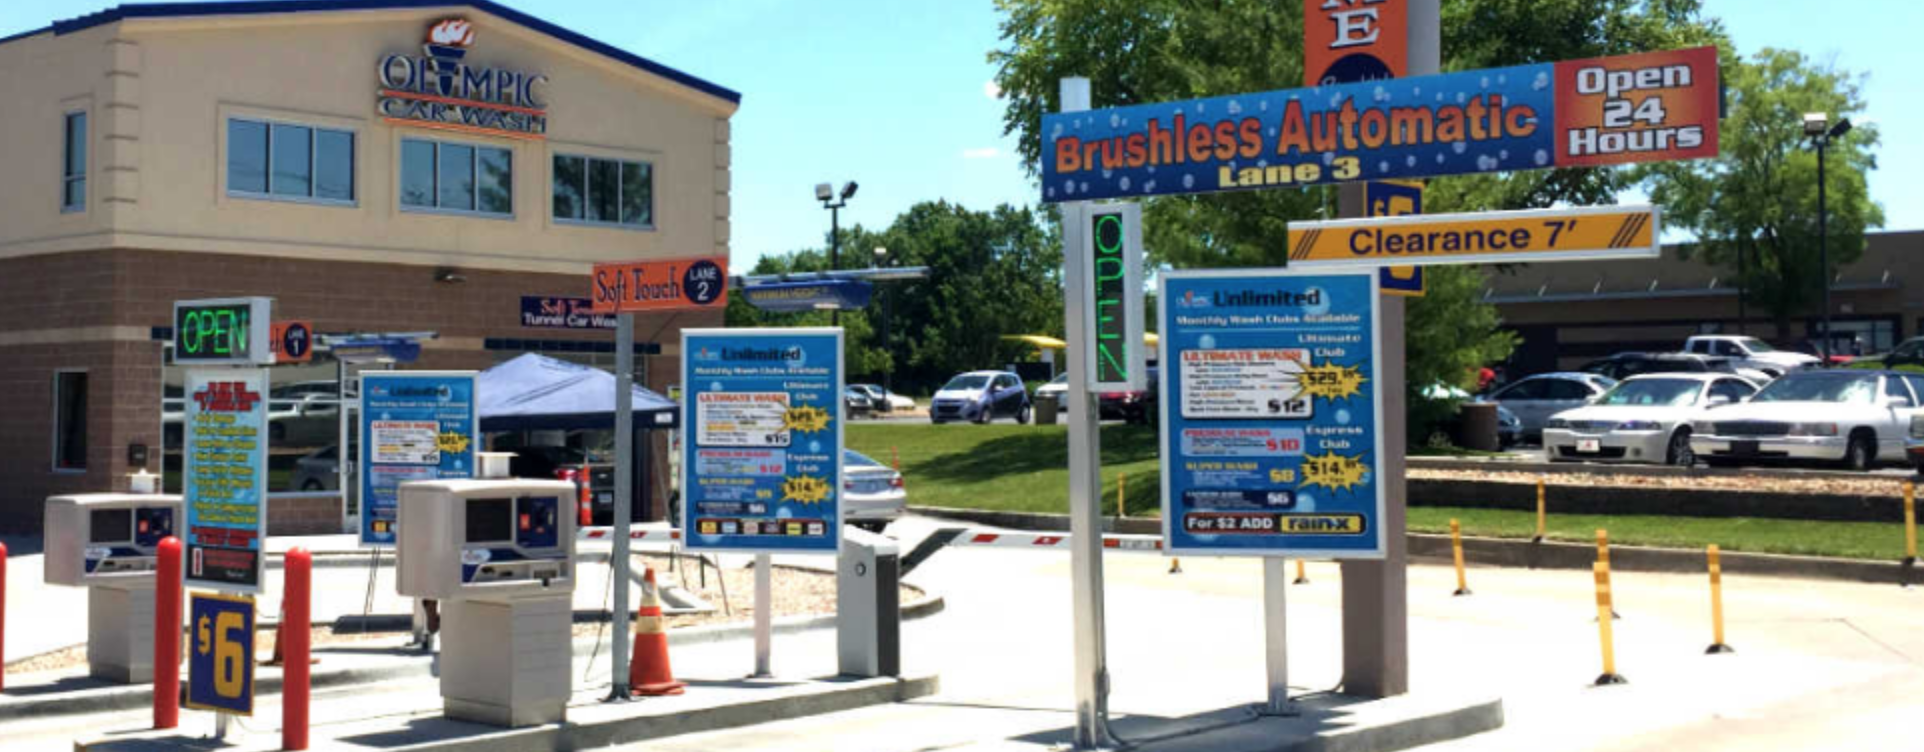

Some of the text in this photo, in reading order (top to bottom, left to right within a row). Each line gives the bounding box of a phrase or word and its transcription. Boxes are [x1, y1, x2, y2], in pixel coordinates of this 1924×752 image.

[1576, 65, 1692, 98] Open
[379, 98, 547, 134] CAR WASH
[1603, 96, 1667, 127] 24
[1056, 94, 1538, 174] Brushless Automatic
[1568, 125, 1703, 156] Hours
[1218, 156, 1361, 188] Lane 3
[1348, 227, 1531, 256] Clearance
[689, 267, 716, 281] LANE
[596, 266, 681, 315] Soft Touch
[697, 281, 709, 301] 2
[1095, 215, 1128, 381] OPEN
[1213, 289, 1320, 307] Unlimited
[183, 309, 249, 353] OPEN
[524, 313, 565, 326] Tunnel
[567, 315, 588, 328] Car
[1176, 315, 1228, 327] Monthly
[1230, 314, 1264, 323] Wash
[293, 340, 300, 355] 1
[1183, 351, 1253, 361] ULTIMATE
[1315, 348, 1345, 357] Club
[1306, 425, 1363, 435] Express
[1320, 440, 1350, 448] Club
[1187, 517, 1211, 529] For
[1217, 516, 1236, 530] $2
[1240, 516, 1273, 529] ADD
[197, 610, 245, 699] $6
